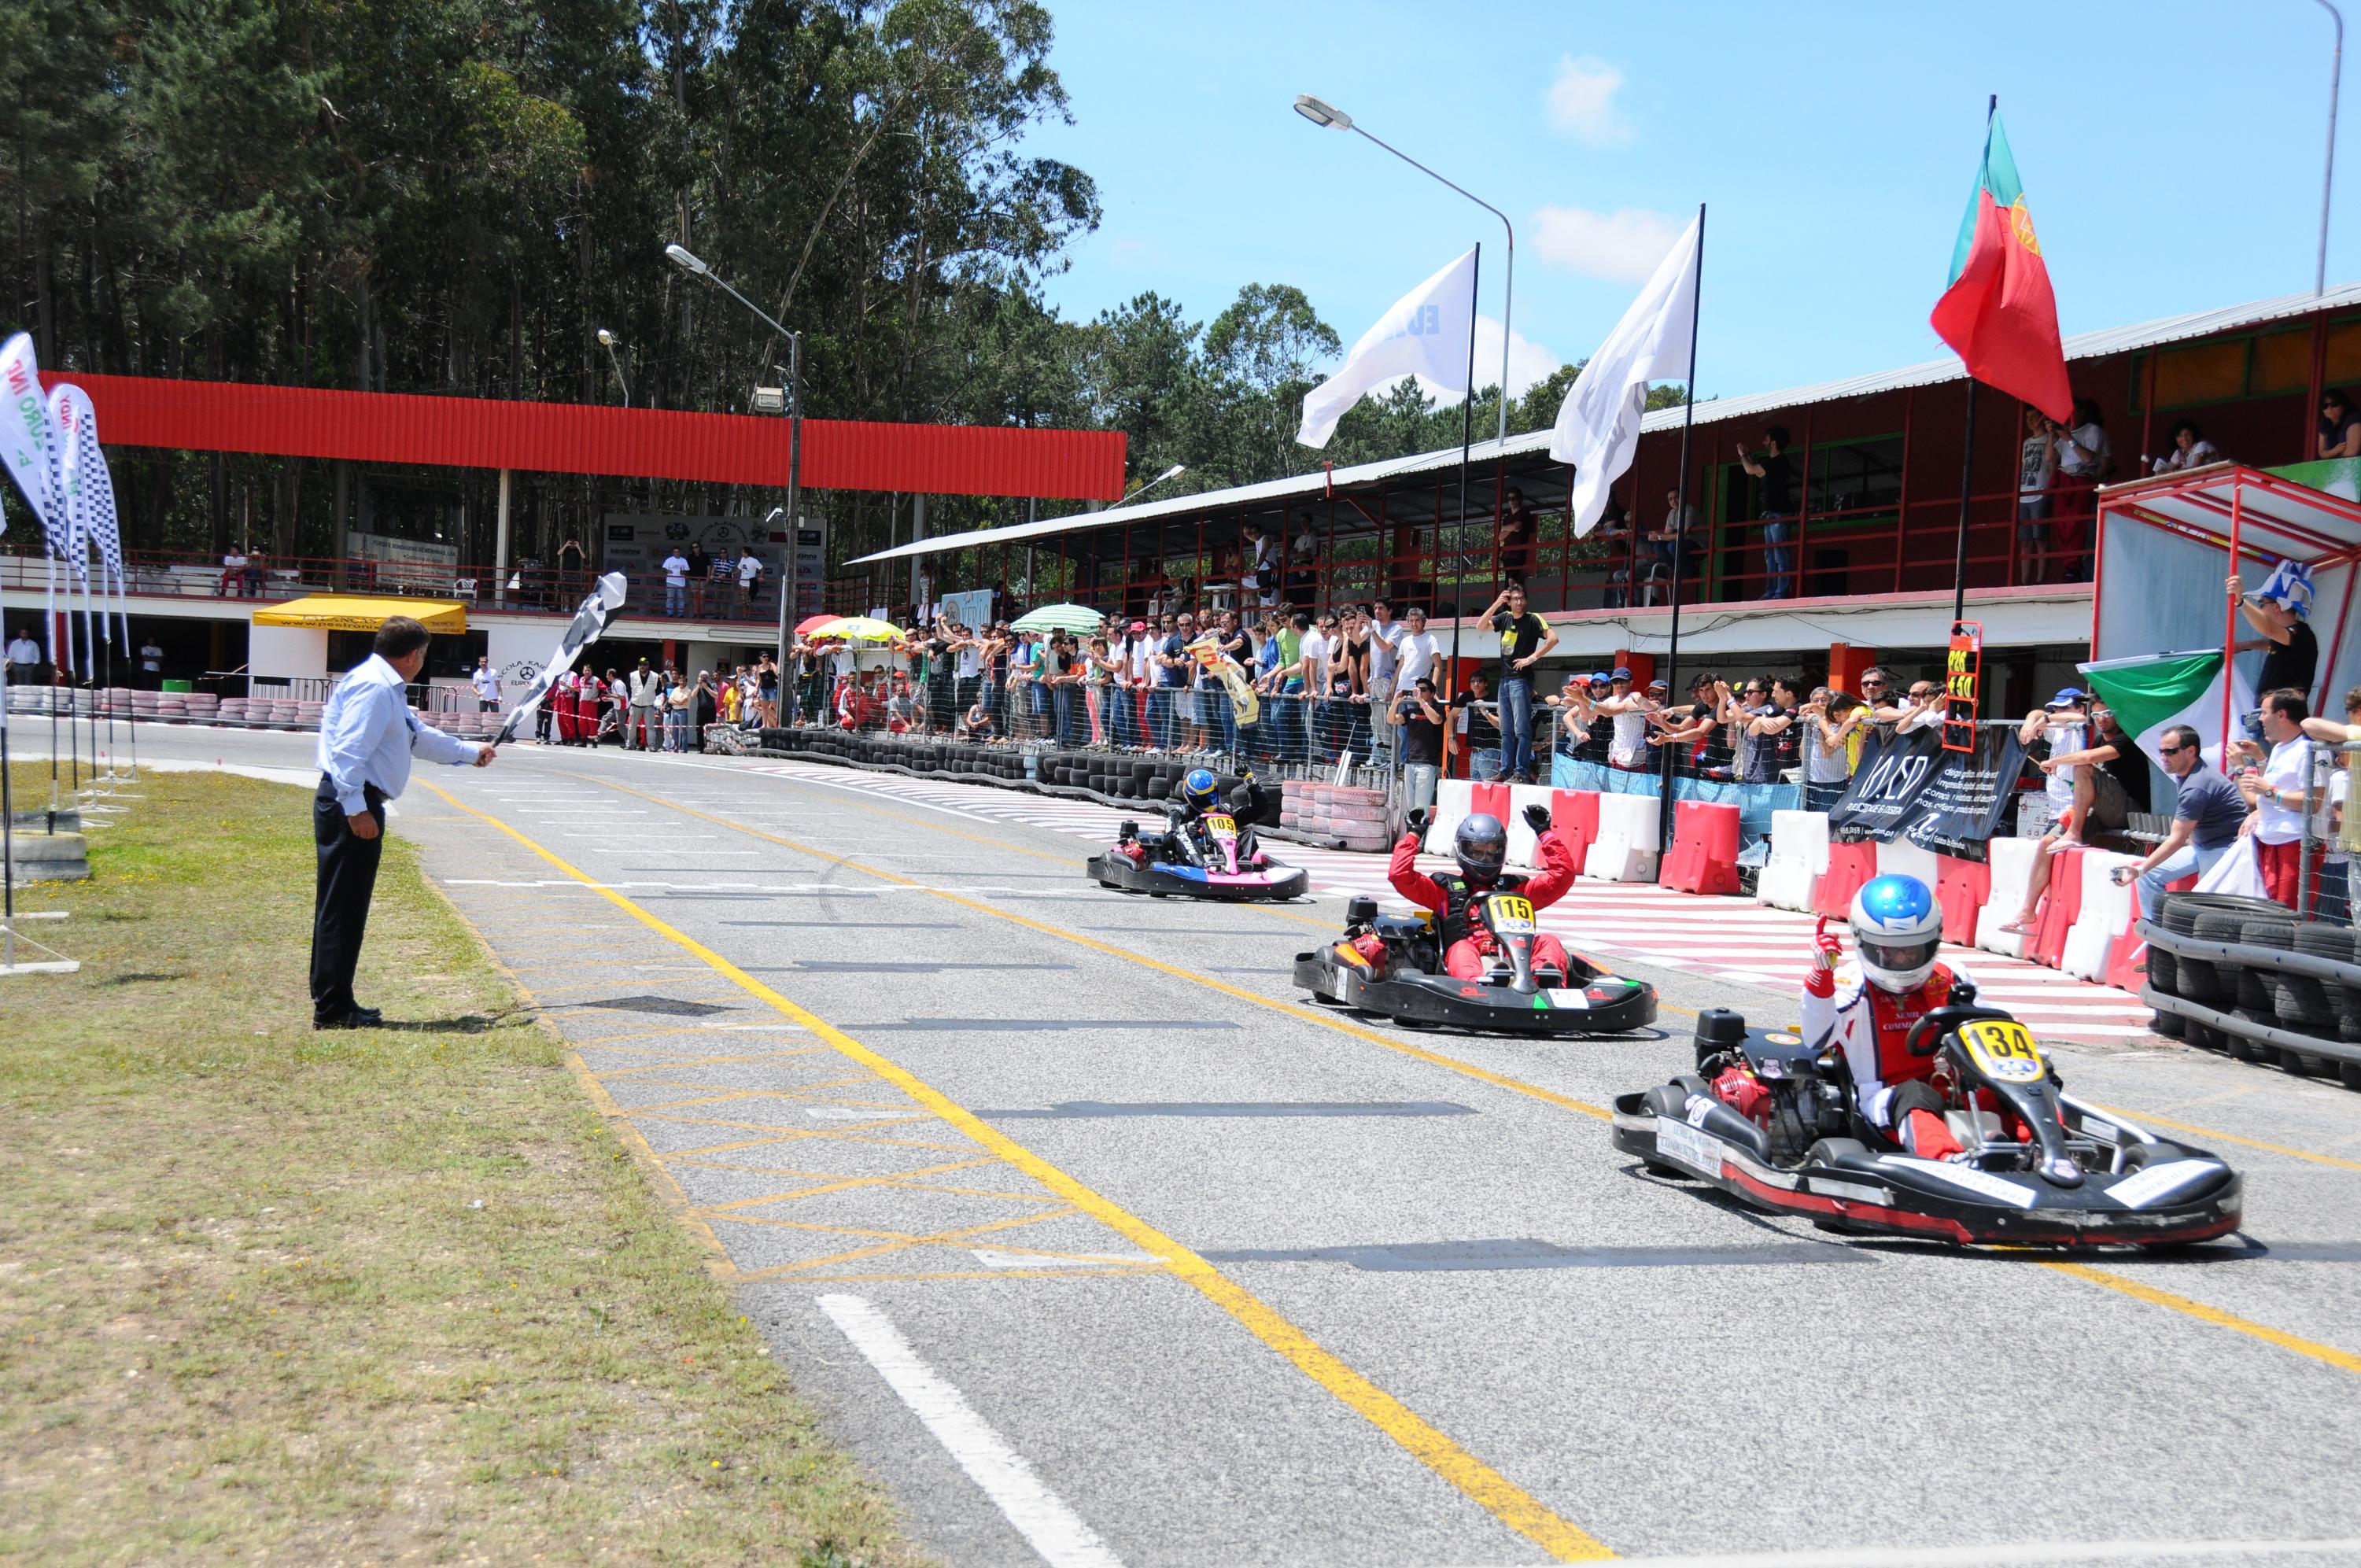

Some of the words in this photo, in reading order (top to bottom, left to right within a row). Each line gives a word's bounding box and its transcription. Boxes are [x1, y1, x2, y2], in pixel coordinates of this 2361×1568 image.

[1211, 818, 1234, 831] 105
[1493, 899, 1529, 920] 115
[1966, 1026, 2034, 1060] 134
